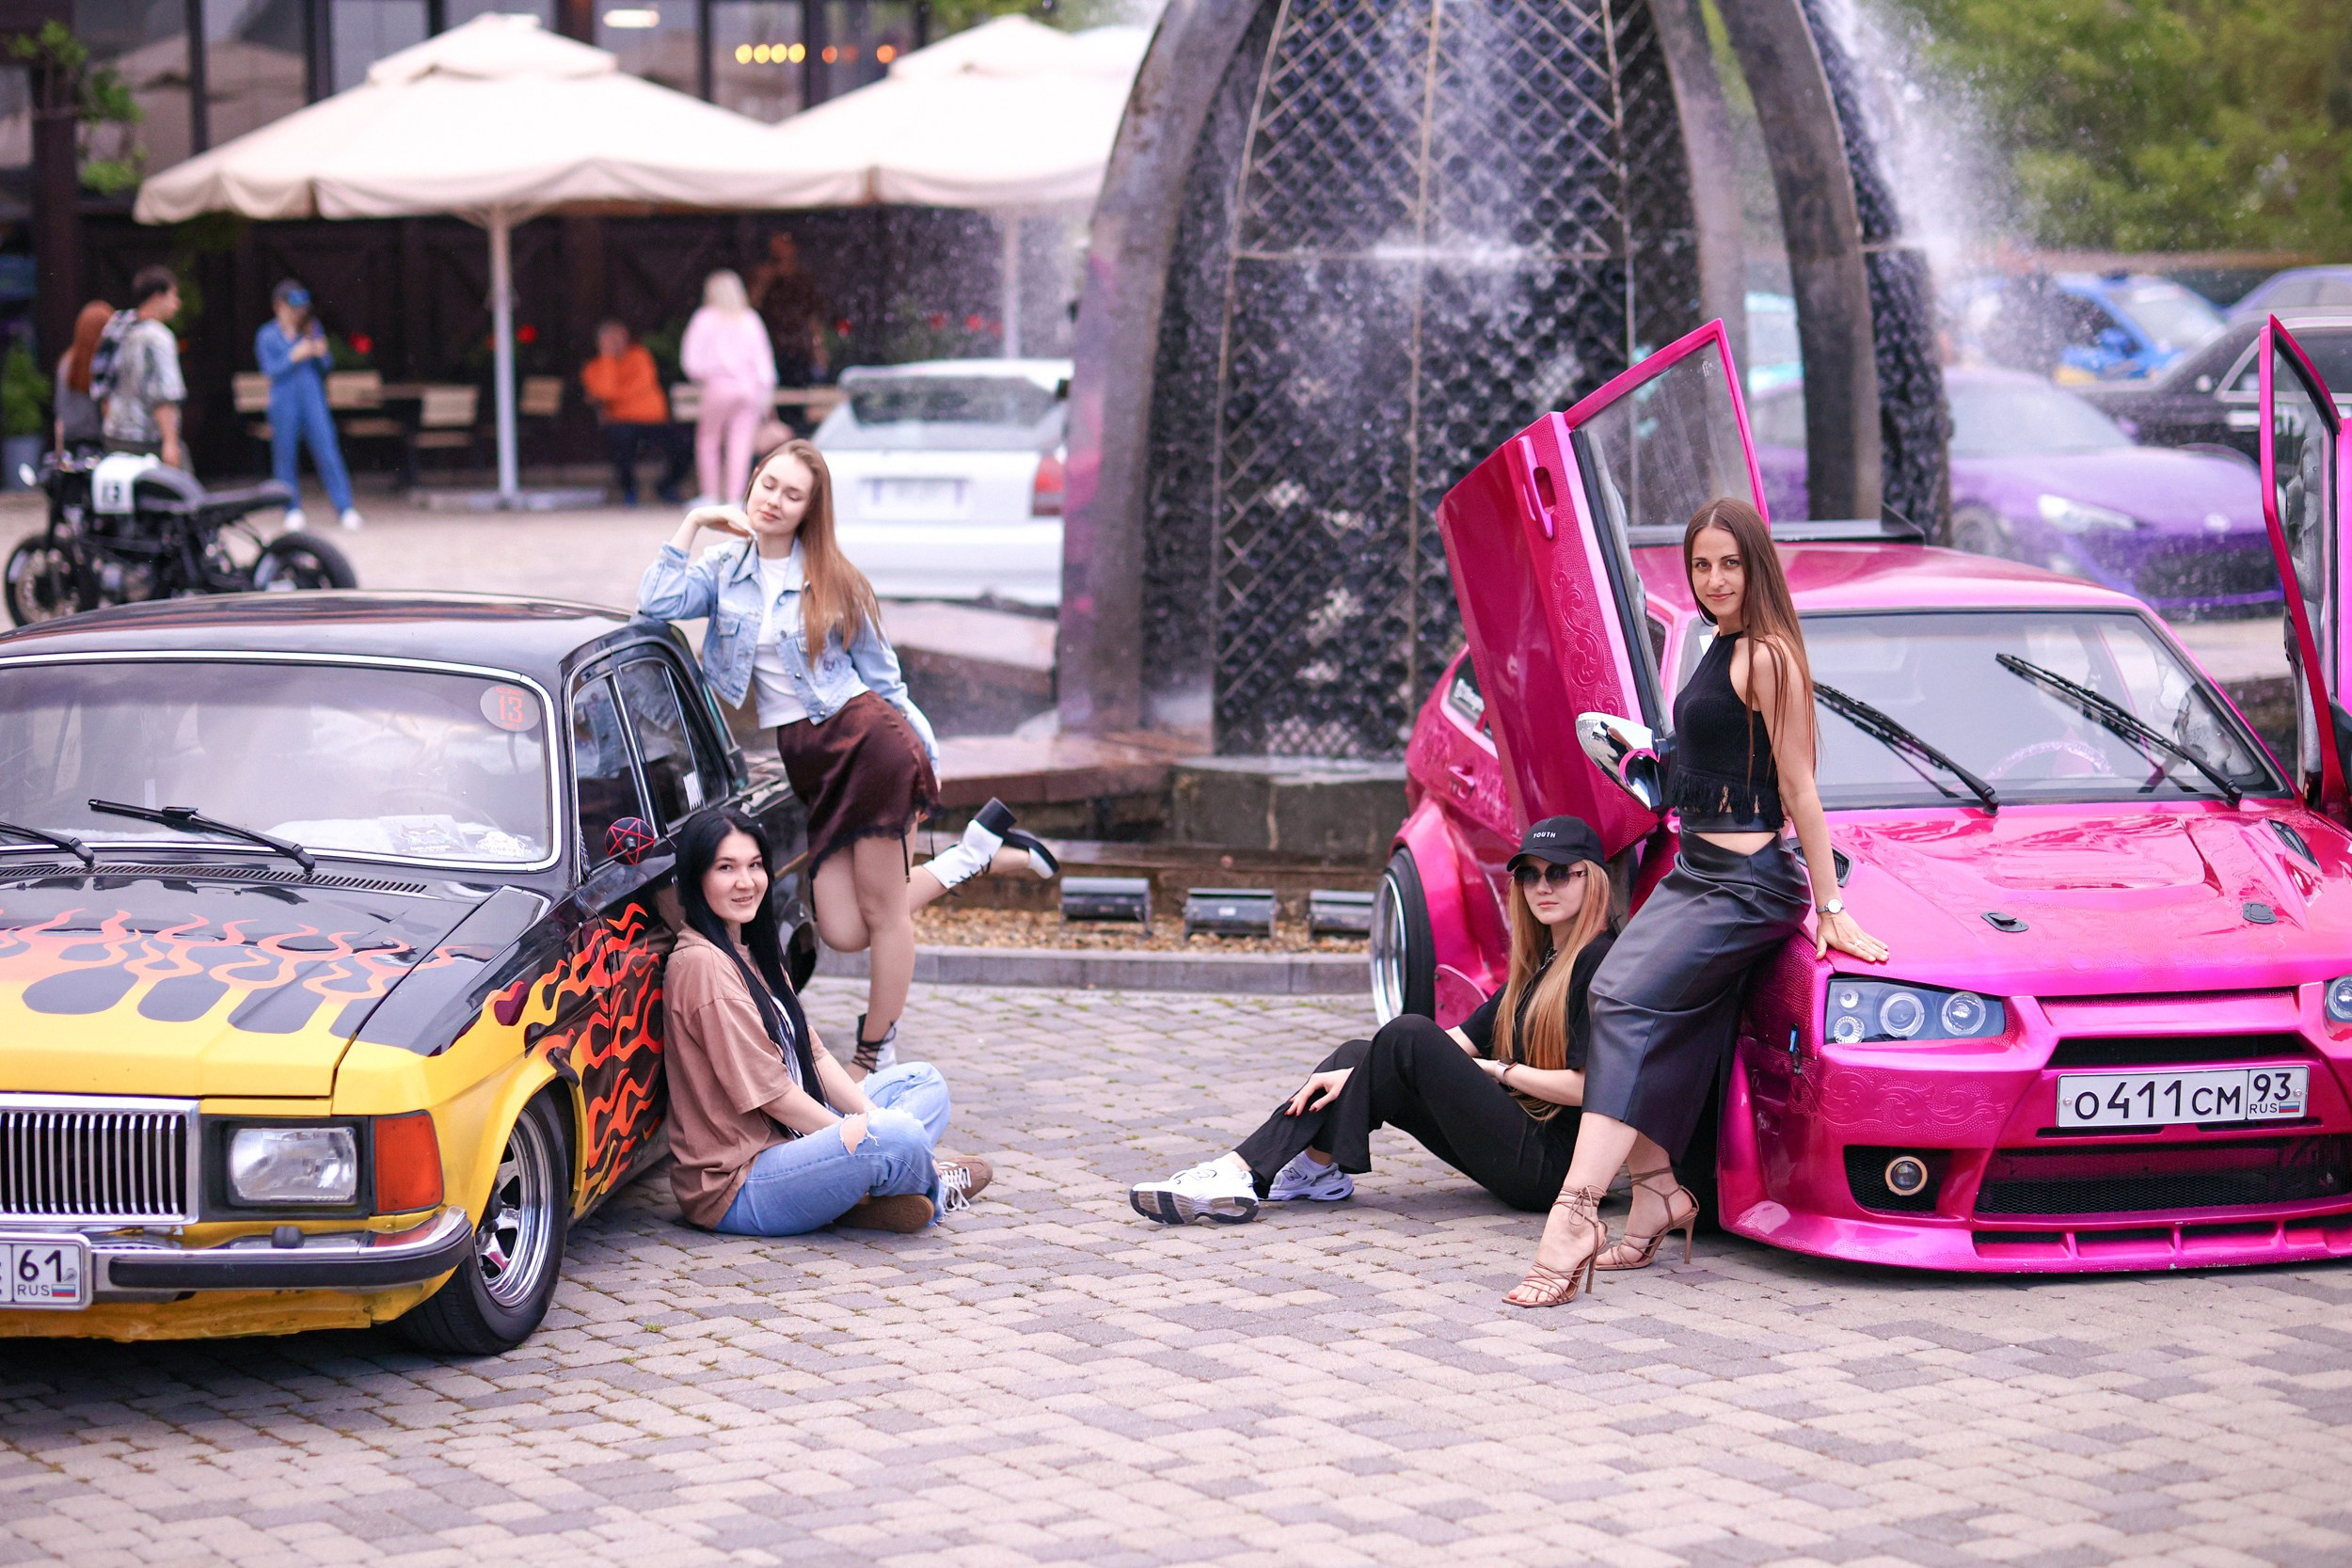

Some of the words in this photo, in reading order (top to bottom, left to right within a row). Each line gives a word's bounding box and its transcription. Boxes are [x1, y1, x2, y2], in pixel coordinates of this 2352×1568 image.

[499, 694, 524, 723] 13
[2253, 1072, 2292, 1102] 93
[2249, 1102, 2278, 1115] RUS
[19, 1249, 62, 1283] 61
[17, 1284, 50, 1296] RUS
